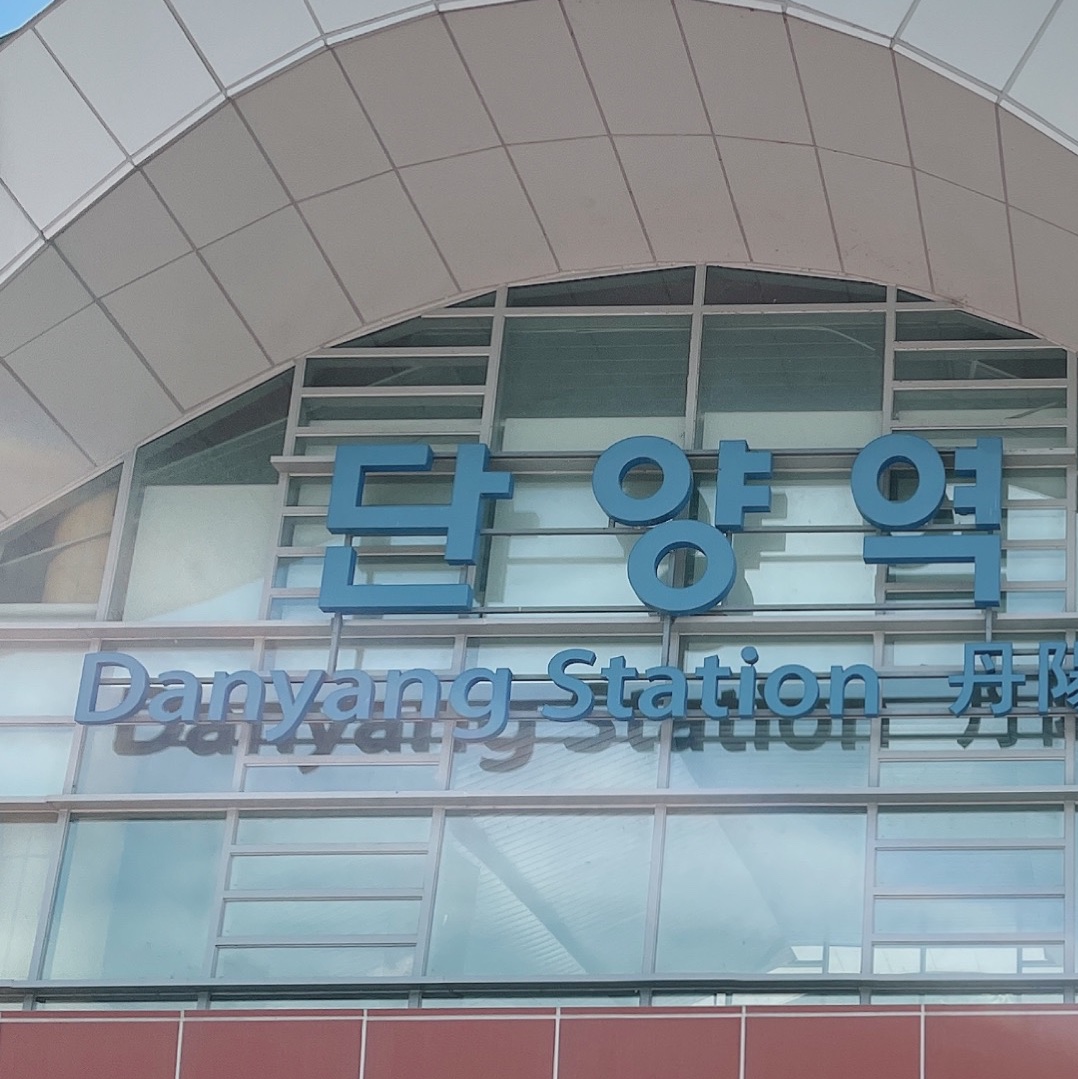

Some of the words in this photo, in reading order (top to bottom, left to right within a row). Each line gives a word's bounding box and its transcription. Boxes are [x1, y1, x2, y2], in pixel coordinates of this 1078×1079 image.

[319, 434, 1003, 615] 단양역
[74, 651, 512, 740] Danyang
[540, 646, 880, 721] Station
